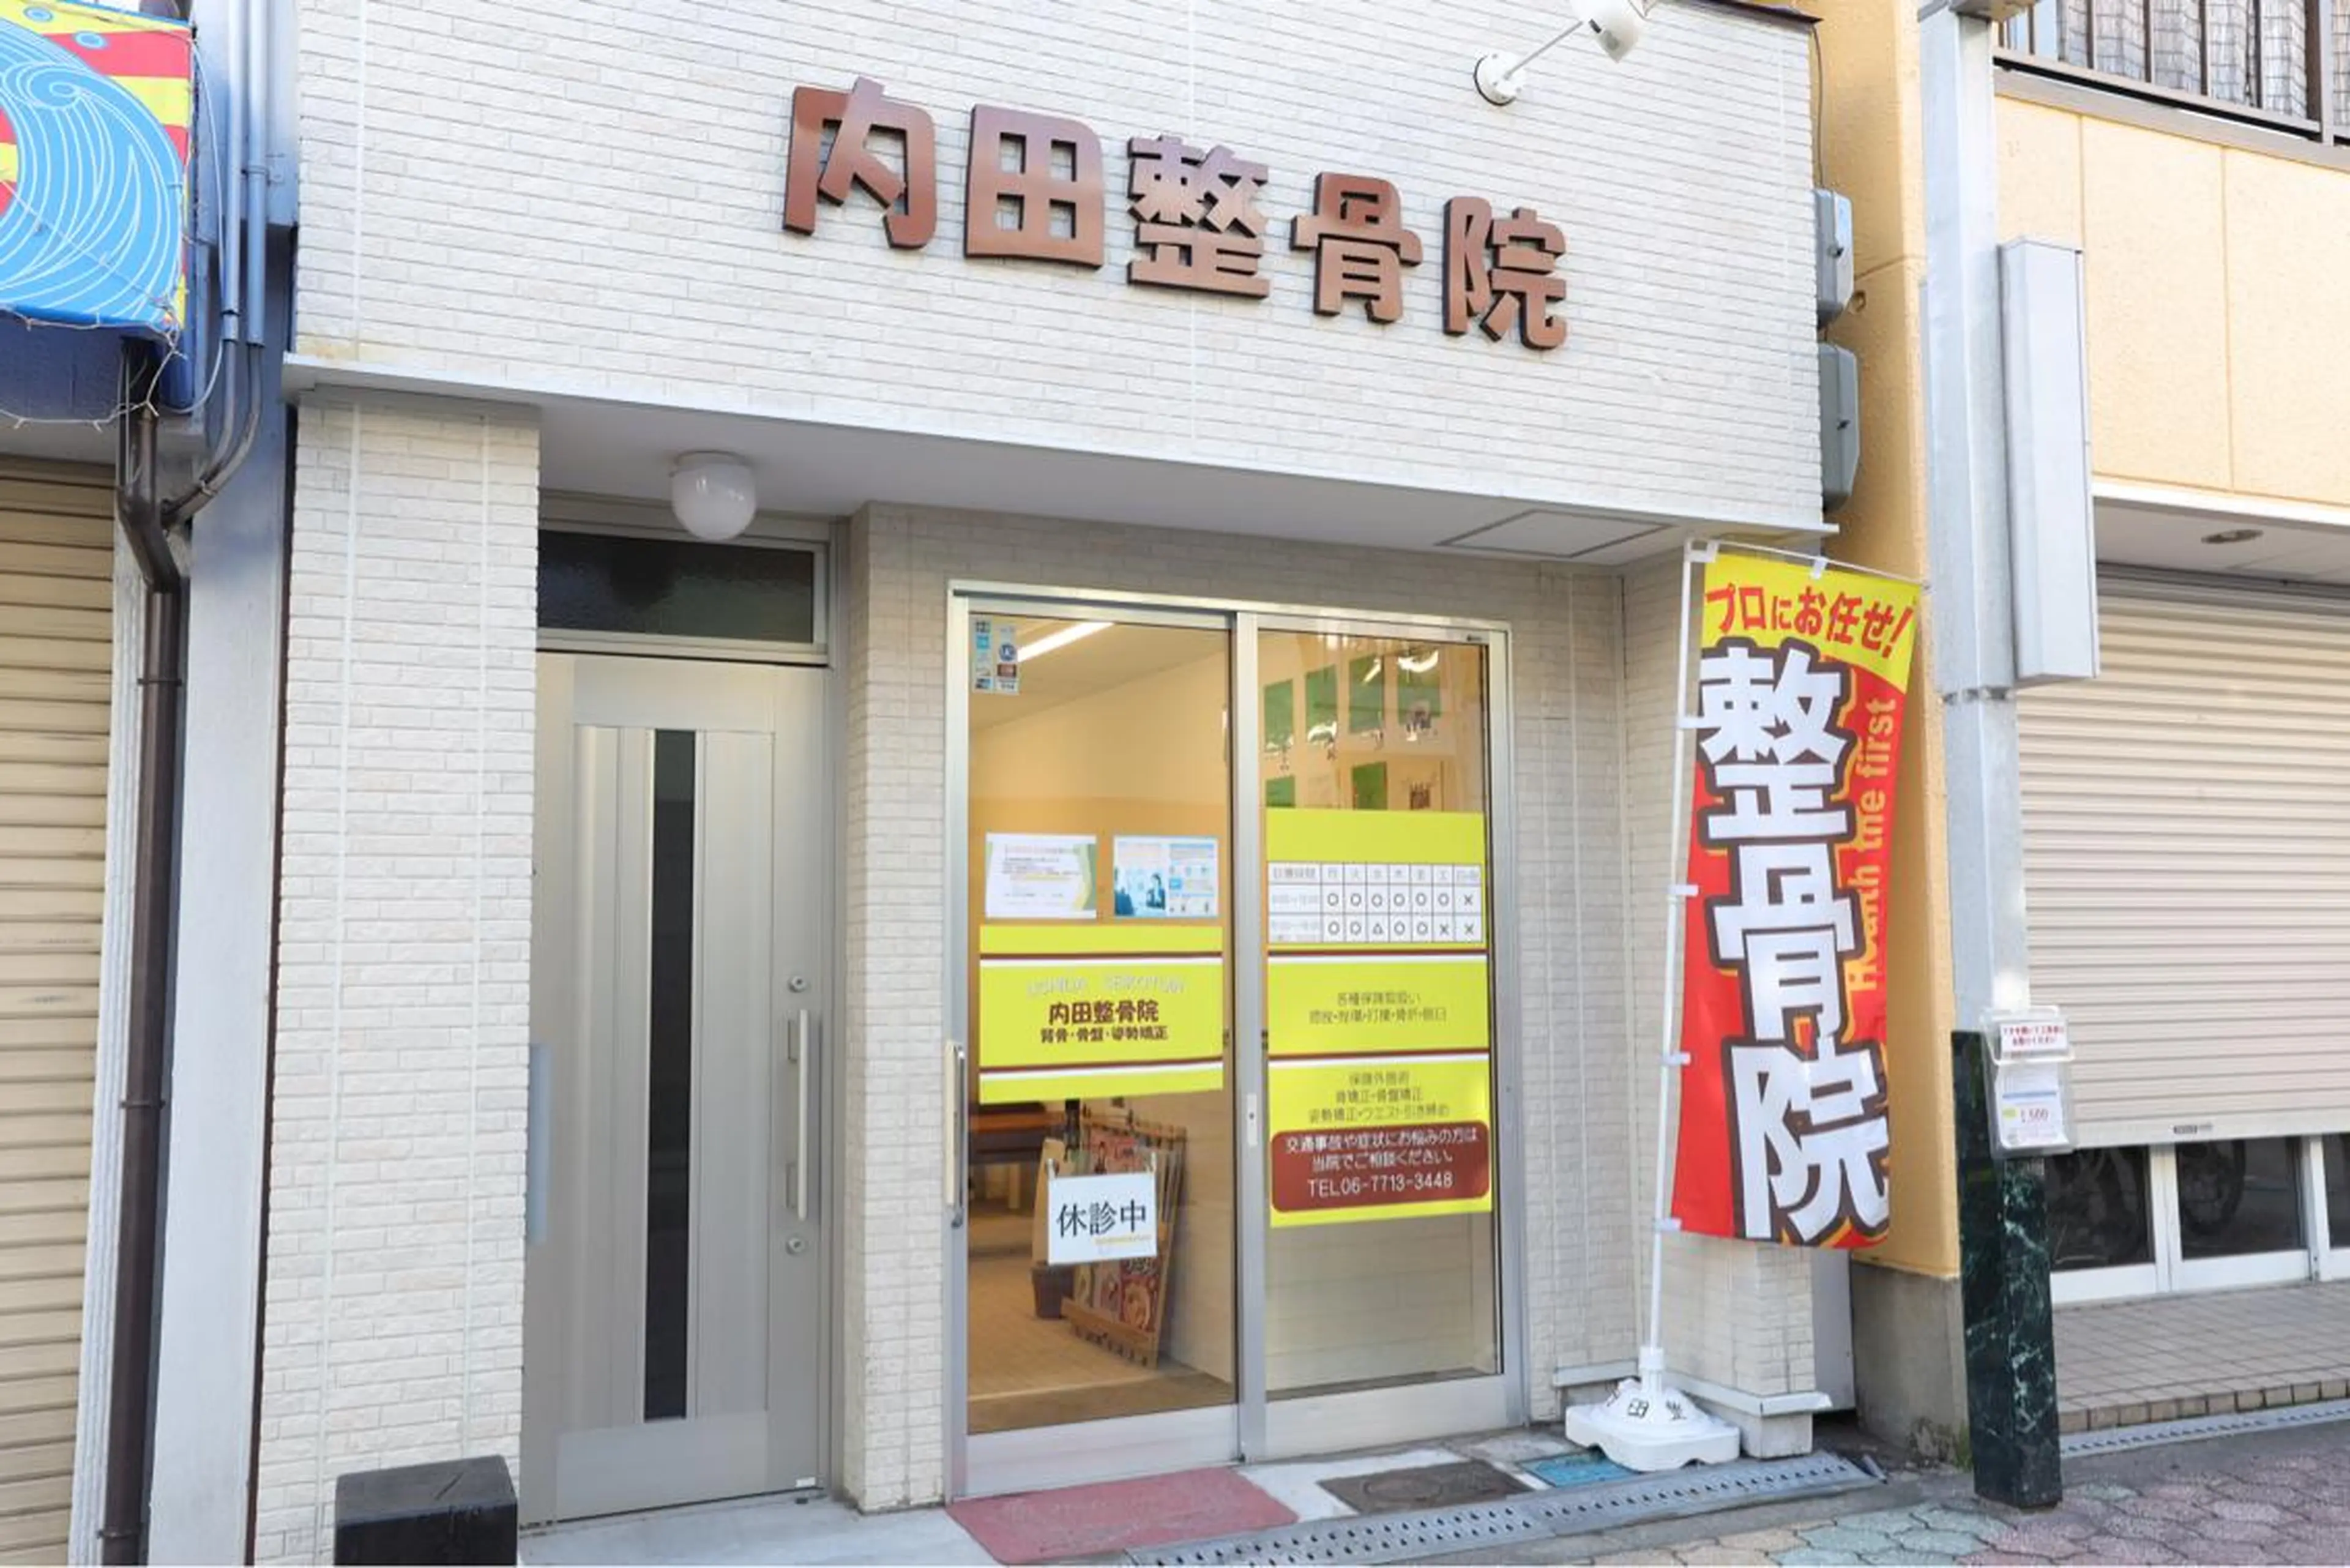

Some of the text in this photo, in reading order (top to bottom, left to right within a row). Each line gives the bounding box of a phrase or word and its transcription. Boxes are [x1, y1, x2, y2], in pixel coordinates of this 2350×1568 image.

[783, 77, 1567, 349] 内田整骨院
[1705, 583, 1914, 659] プロにお任せ!
[1856, 698, 1896, 778] first
[1699, 647, 1890, 1240] 整骨院
[1049, 999, 1159, 1025] 内田整骨院
[1056, 1198, 1146, 1239] 休診中
